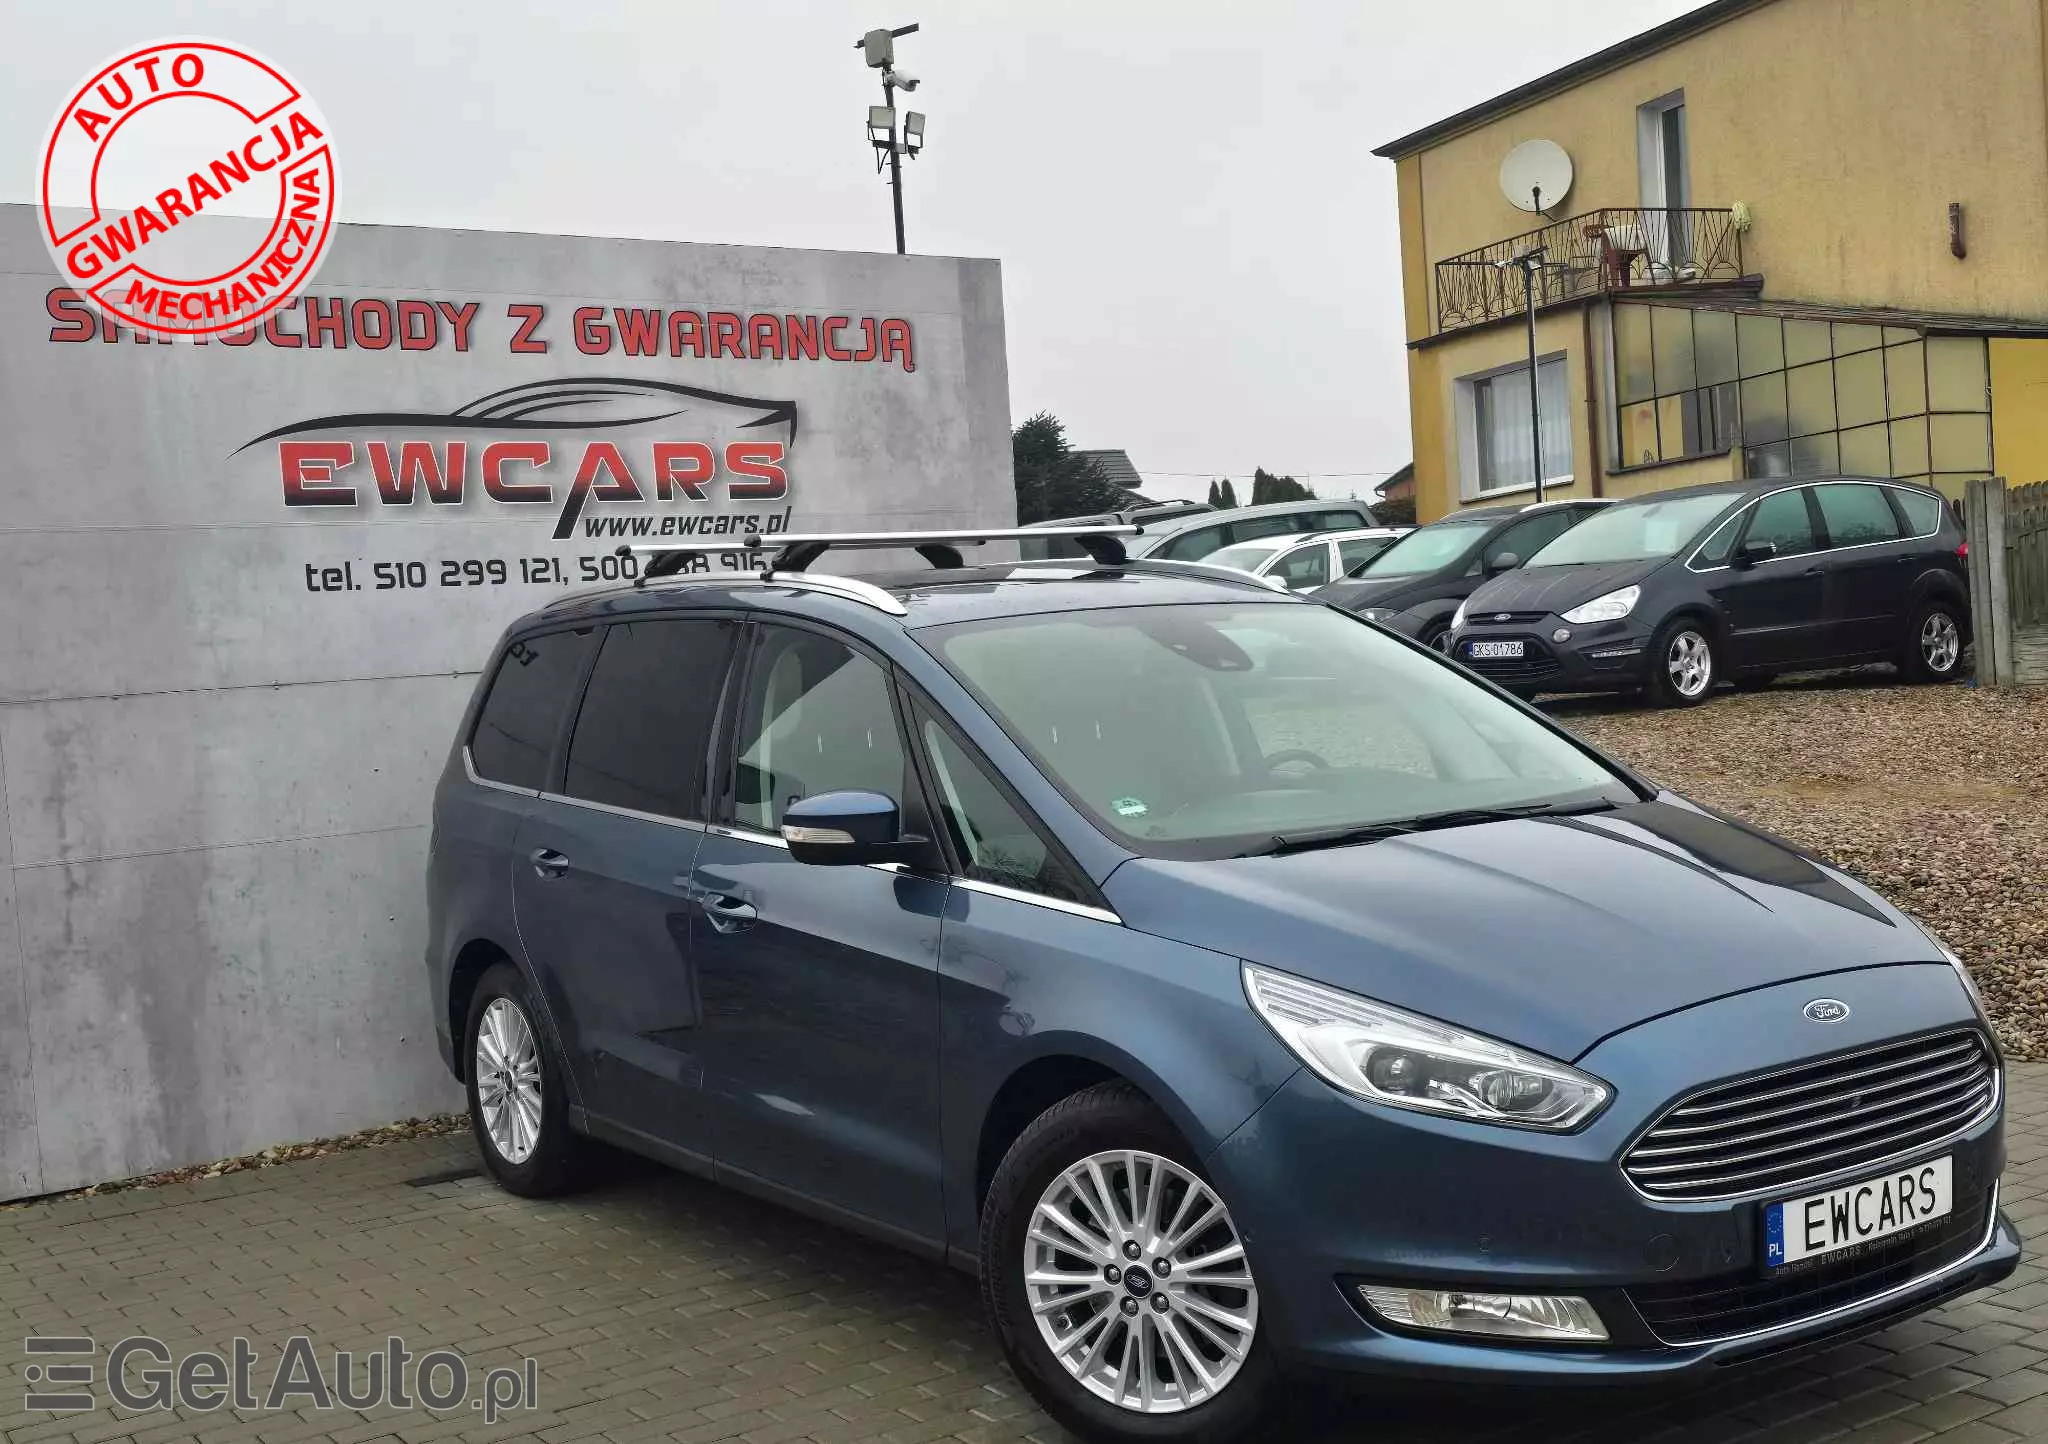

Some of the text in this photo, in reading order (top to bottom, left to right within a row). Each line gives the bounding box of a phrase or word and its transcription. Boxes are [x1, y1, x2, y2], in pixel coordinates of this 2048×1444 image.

[46, 287, 480, 352] SAMOCHODY
[507, 304, 548, 354] Z
[278, 440, 789, 541] EWCARS
[585, 505, 793, 538] www.ewcars.pl
[305, 562, 362, 593] tel.
[373, 562, 427, 590] 510
[440, 558, 507, 587] 299
[520, 556, 569, 587] 121,
[579, 555, 639, 582] 500
[1813, 1003, 1841, 1018] Ford
[1803, 1166, 1936, 1252] EWCARS
[1768, 1242, 1784, 1258] PL
